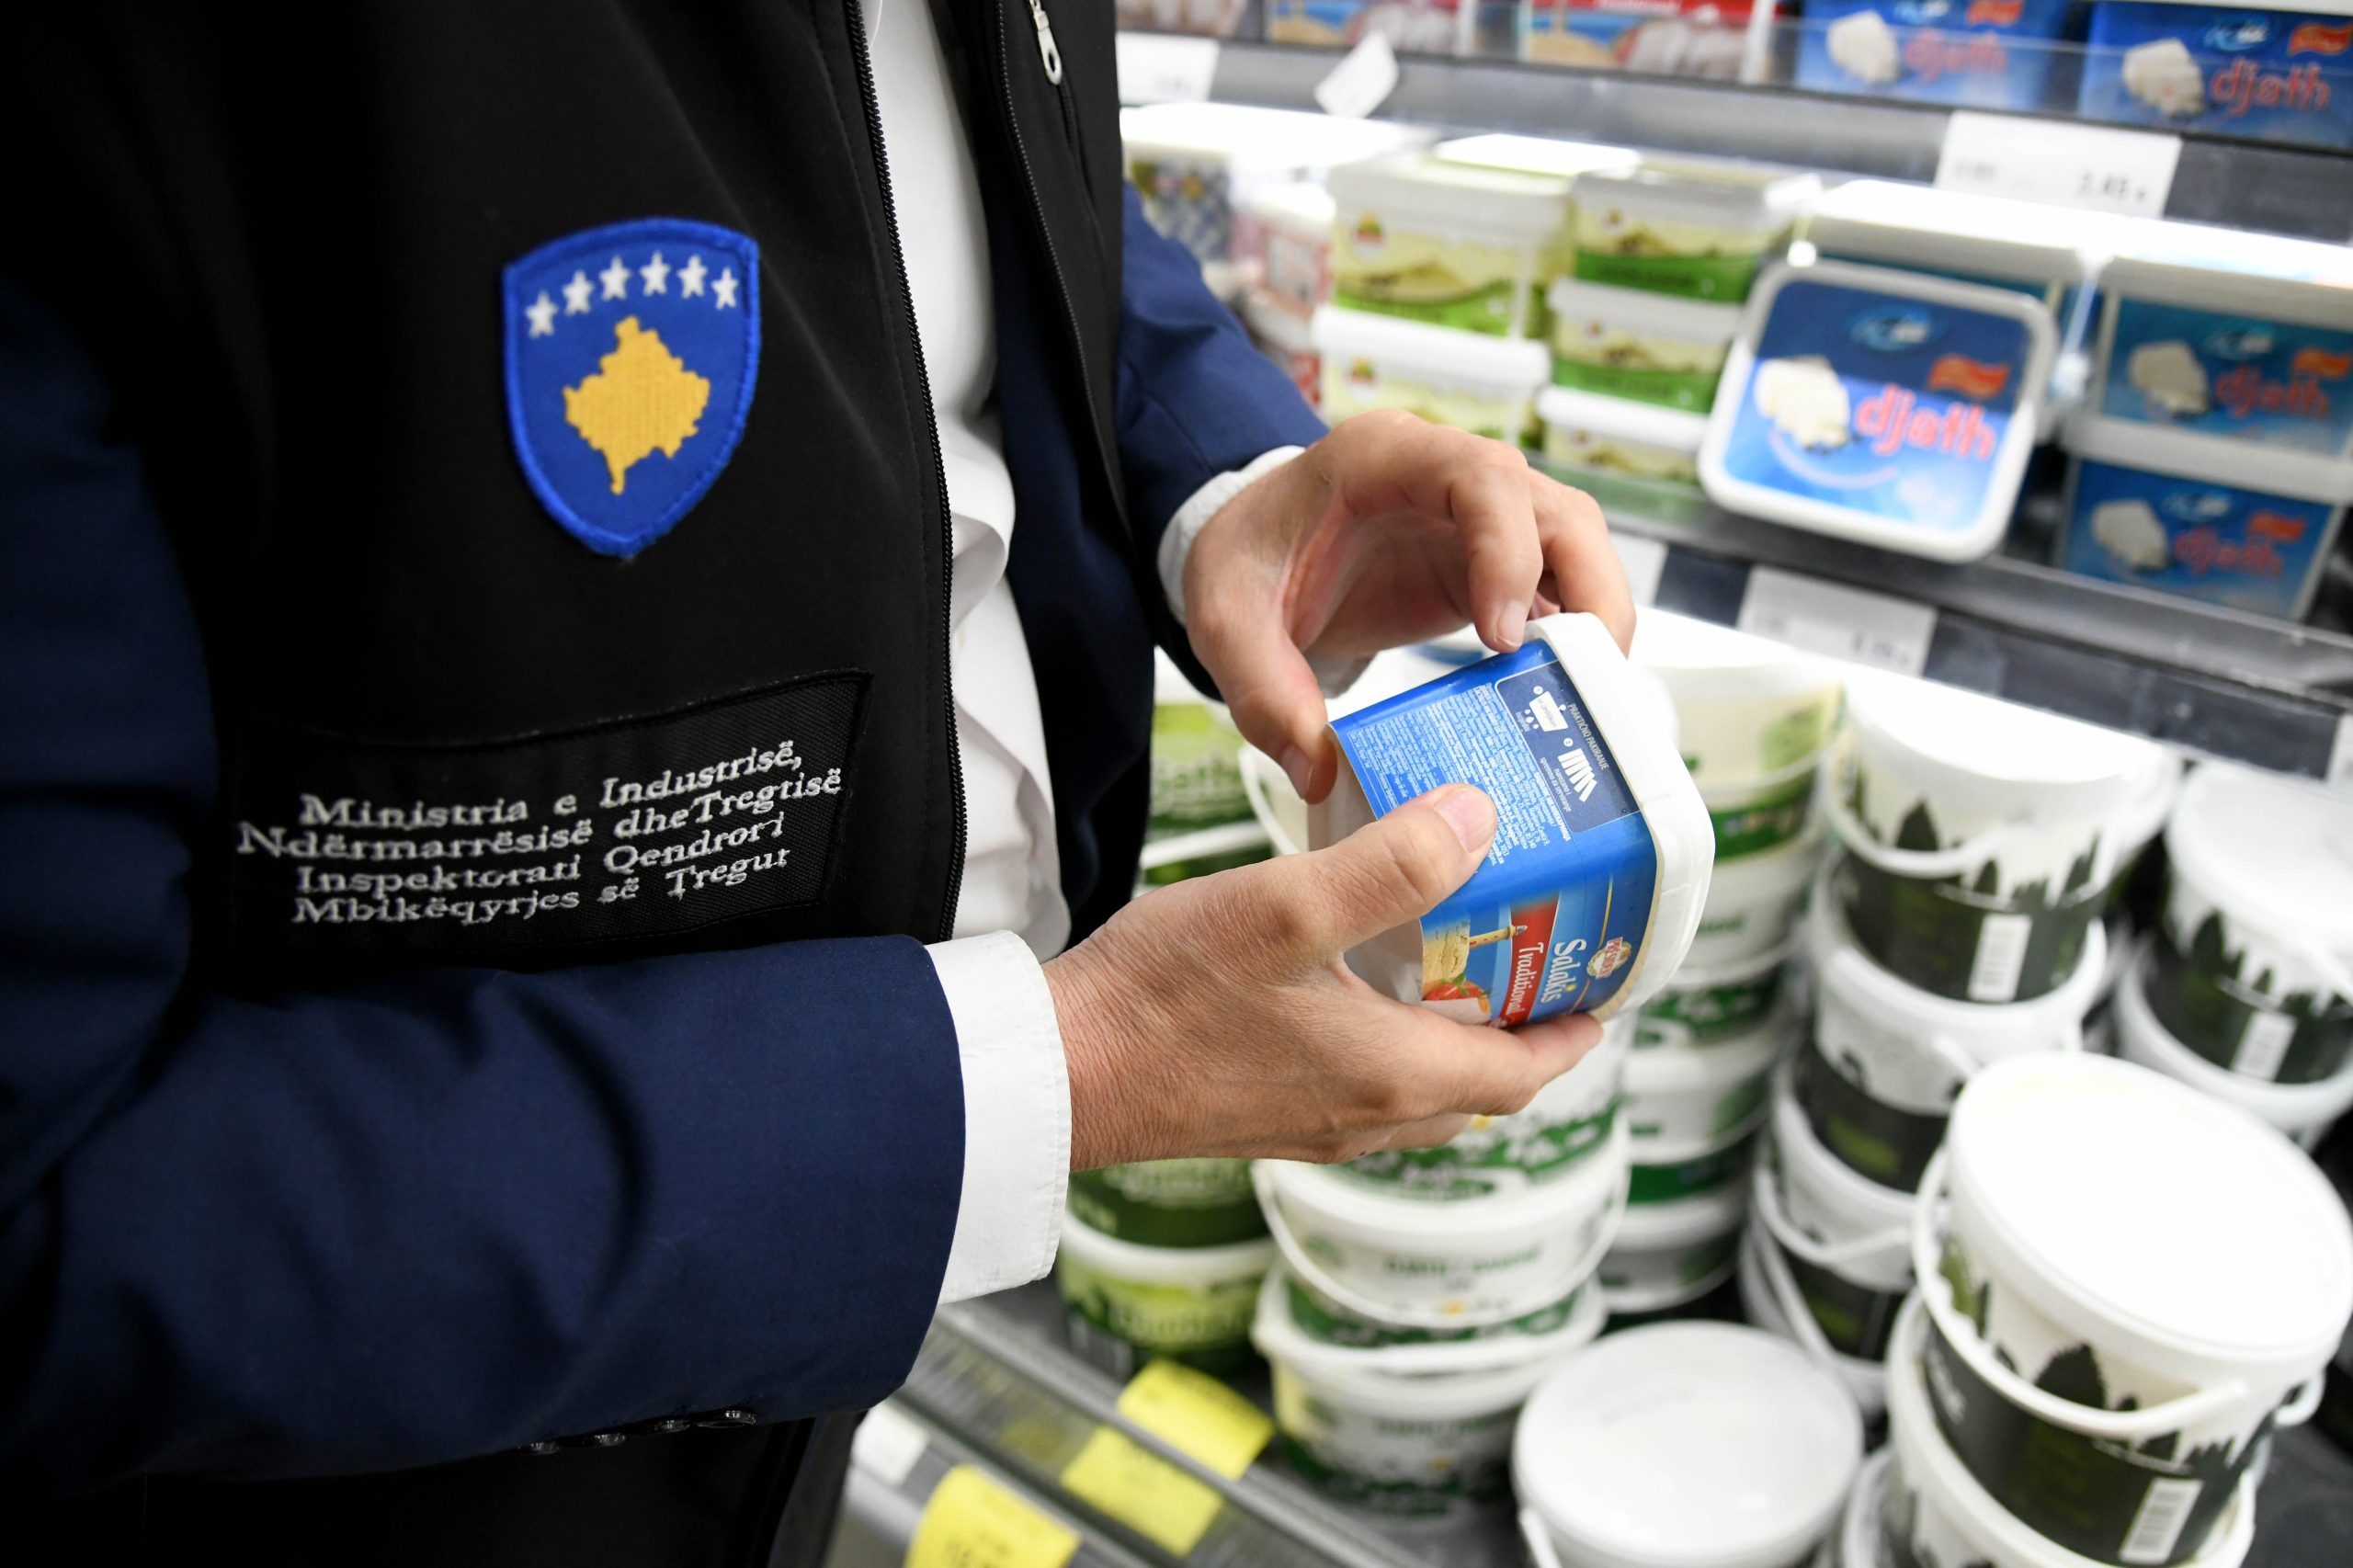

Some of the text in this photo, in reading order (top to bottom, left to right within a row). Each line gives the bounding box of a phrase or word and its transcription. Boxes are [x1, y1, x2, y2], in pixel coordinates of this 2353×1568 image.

[2211, 57, 2331, 116] djath
[1855, 382, 1995, 463] djath
[1586, 736, 1609, 769] PAKIRANJE
[299, 740, 801, 831] Ministria e Industrisë,
[237, 819, 593, 861] Ndërmarrësisë
[291, 847, 790, 926] Mbikëqyrjes së Tregut
[296, 854, 581, 900] Inspektorati
[1506, 941, 1544, 1016] Traditional
[1540, 938, 1586, 1003] Salakis
